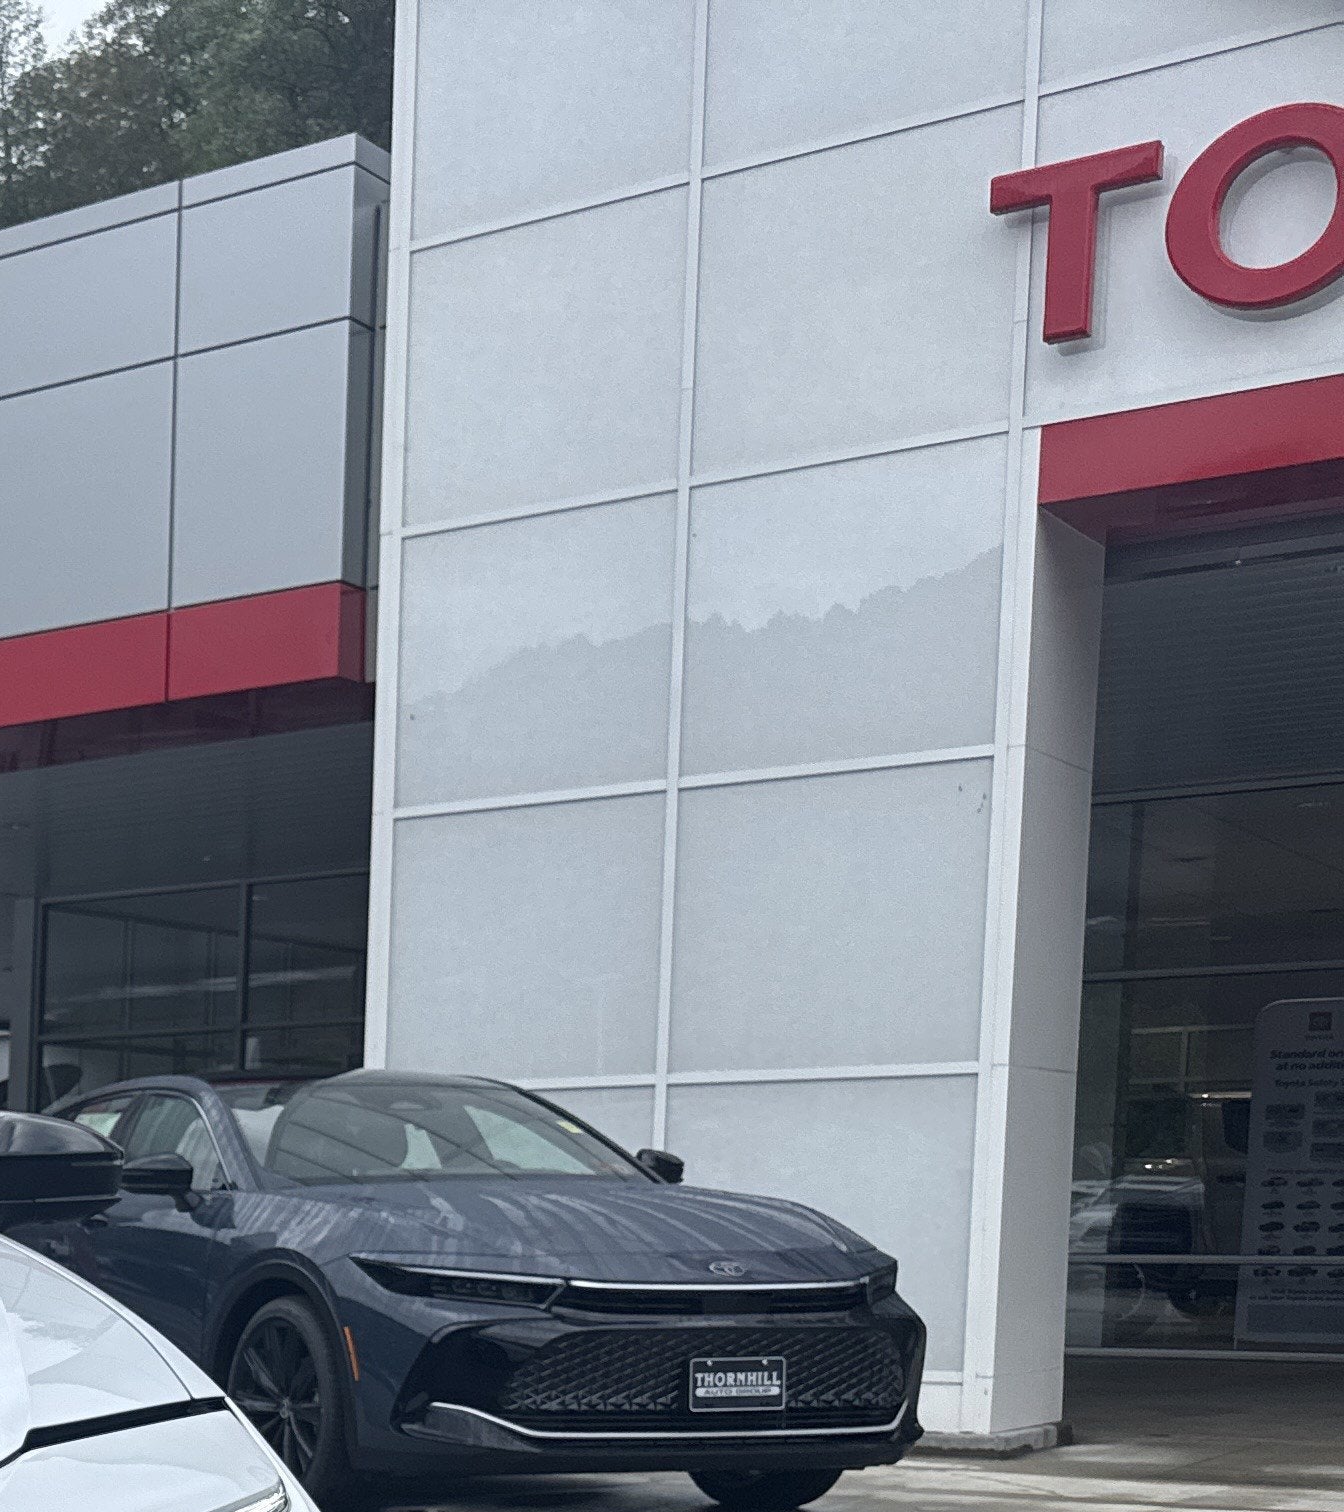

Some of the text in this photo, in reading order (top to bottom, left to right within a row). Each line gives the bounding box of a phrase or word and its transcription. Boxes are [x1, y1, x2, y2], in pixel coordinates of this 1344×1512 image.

[990, 102, 1344, 344] TO
[1270, 1049, 1326, 1059] Standard
[694, 1371, 781, 1387] THORNHILL
